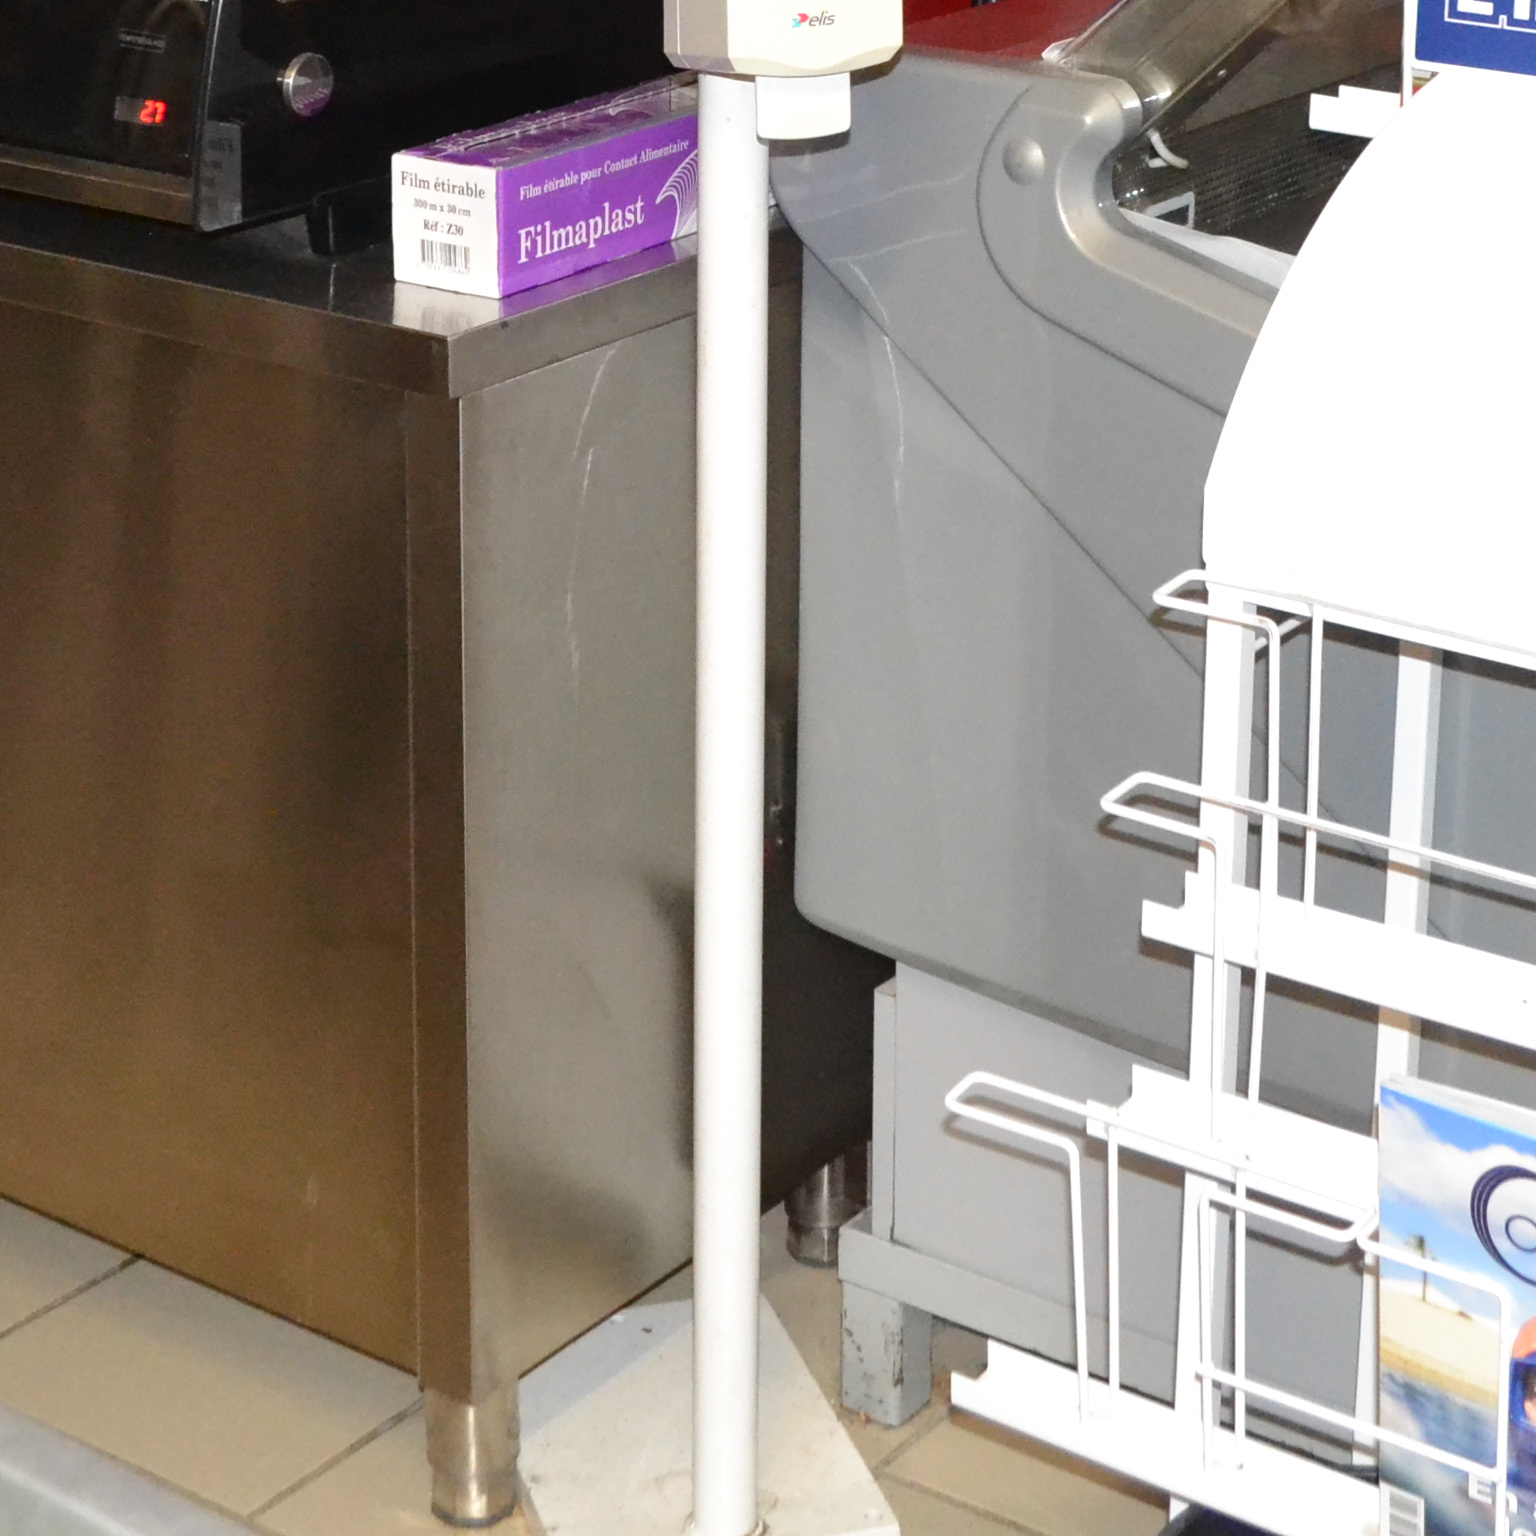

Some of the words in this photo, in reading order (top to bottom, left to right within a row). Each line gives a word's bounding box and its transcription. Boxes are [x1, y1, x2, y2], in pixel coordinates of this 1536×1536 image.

[808, 10, 836, 27] elis
[519, 184, 542, 201] Film
[543, 170, 579, 194] étirable
[580, 166, 603, 185] pour
[603, 154, 638, 175] Contact
[638, 139, 690, 164] Alimentaire
[400, 170, 430, 191] Film
[434, 176, 486, 200] étirable
[429, 202, 438, 212] m
[458, 207, 472, 217] cm
[423, 218, 439, 233] Réf
[446, 222, 465, 237] Z30
[517, 194, 645, 265] Filmaplast
